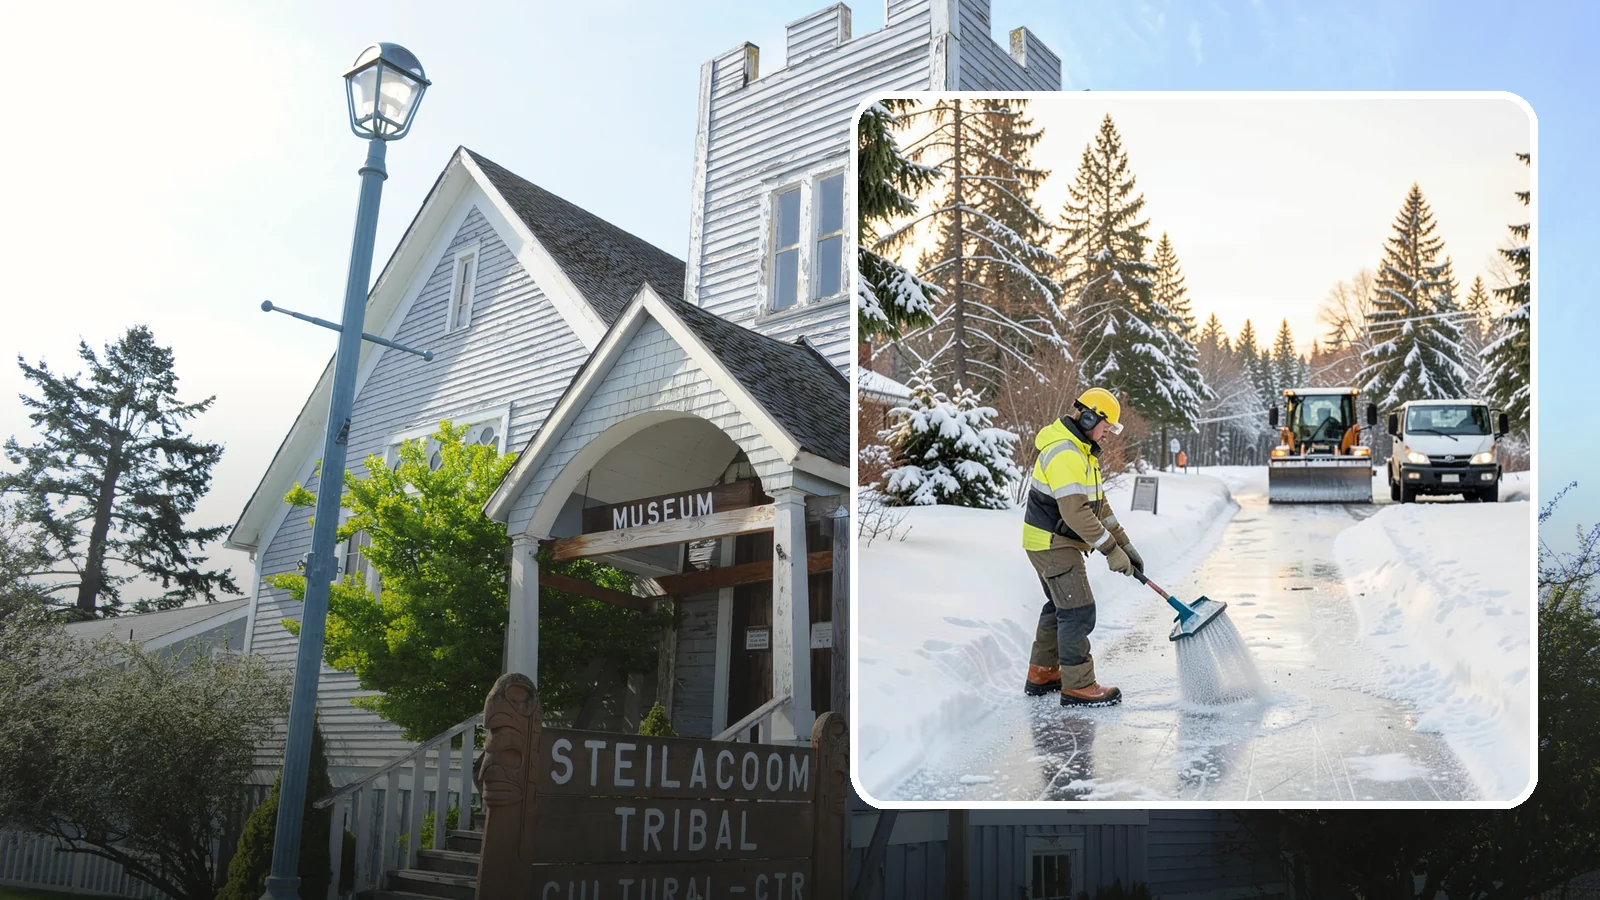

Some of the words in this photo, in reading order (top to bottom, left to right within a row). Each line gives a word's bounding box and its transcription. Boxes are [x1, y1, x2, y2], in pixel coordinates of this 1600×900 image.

[613, 491, 713, 531] MUSEUM
[551, 738, 809, 792] STEILACOOM
[615, 807, 757, 852] TRIBAL
